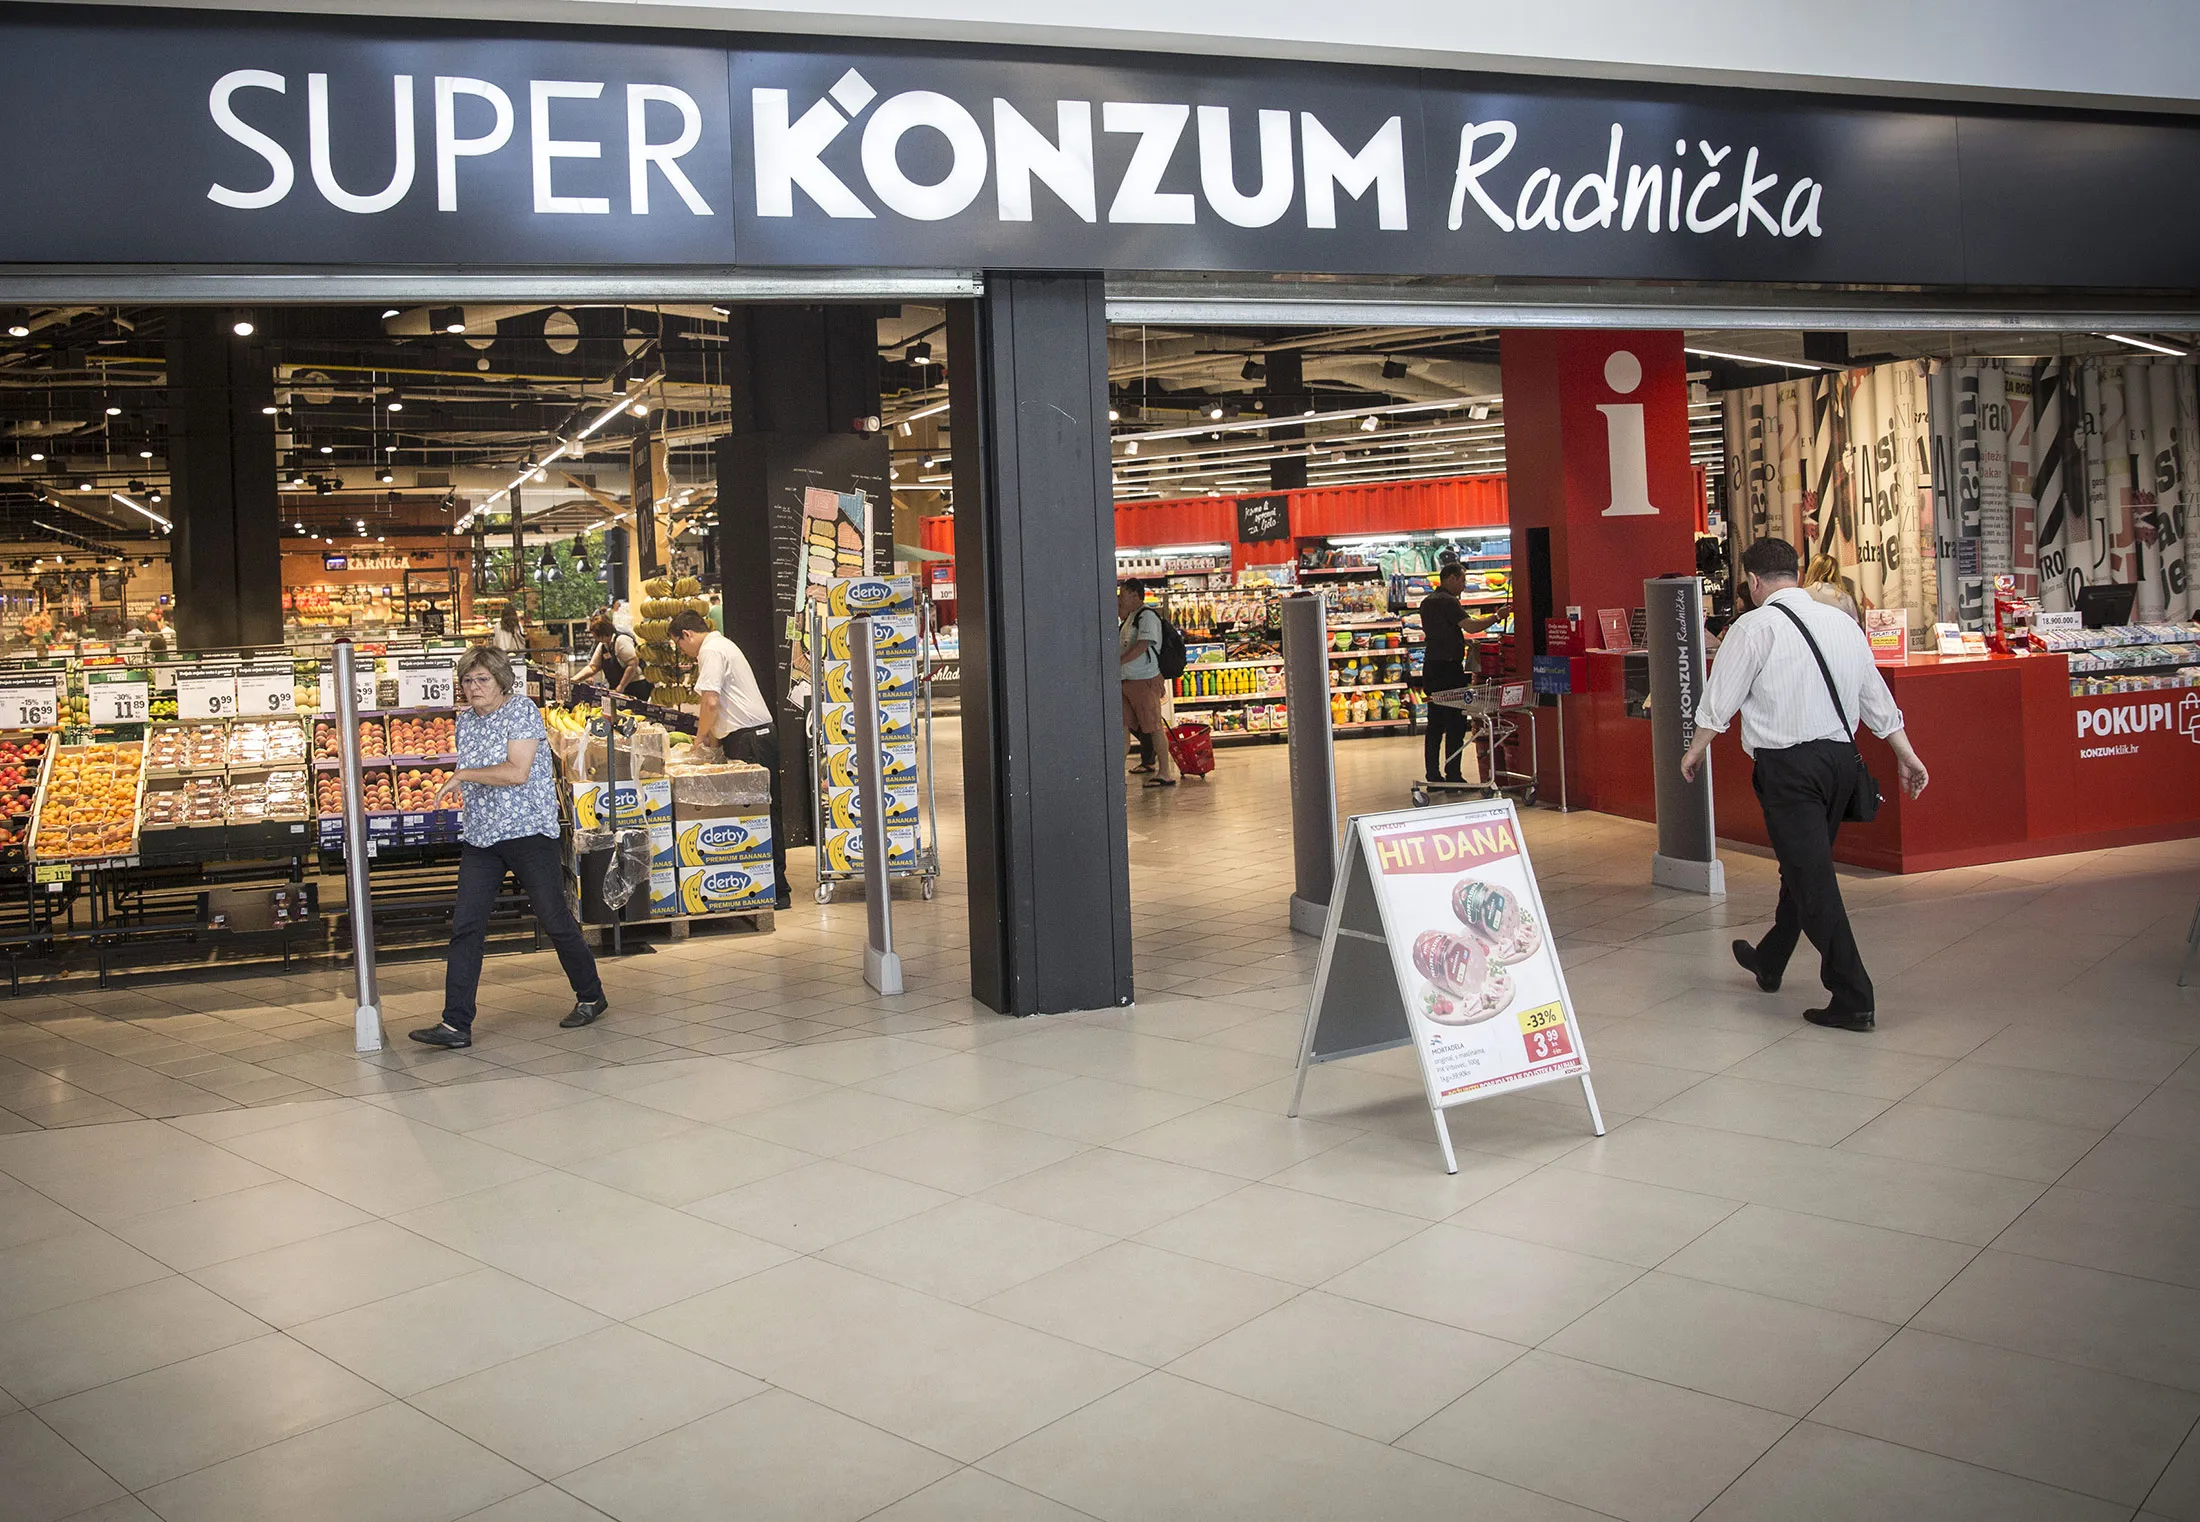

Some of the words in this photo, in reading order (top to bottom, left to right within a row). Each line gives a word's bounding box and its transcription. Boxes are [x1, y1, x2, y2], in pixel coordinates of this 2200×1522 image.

[207, 69, 714, 215] SUPER
[752, 67, 1408, 230] KONZUM
[1448, 120, 1822, 237] Radnička
[346, 556, 411, 570] KARNICA
[851, 584, 889, 603] derby
[1675, 589, 1688, 642] Radnička
[2042, 616, 2073, 625] 18.900.000
[1679, 646, 1693, 720] KONZUM
[2076, 702, 2172, 738] POKUPI
[885, 775, 916, 783] BANANAS
[703, 827, 745, 845] derby
[1376, 836, 1425, 871] HIT
[1431, 824, 1517, 862] DANA
[706, 854, 738, 863] PREMIUM
[739, 852, 771, 861] BANANAS
[707, 874, 748, 891] derby
[651, 906, 676, 914] NANAS
[709, 901, 741, 909] PREMIUM
[742, 898, 774, 906] BANANAS
[1527, 1008, 1556, 1028] -33%
[1431, 1043, 1464, 1055] MORTADELA
